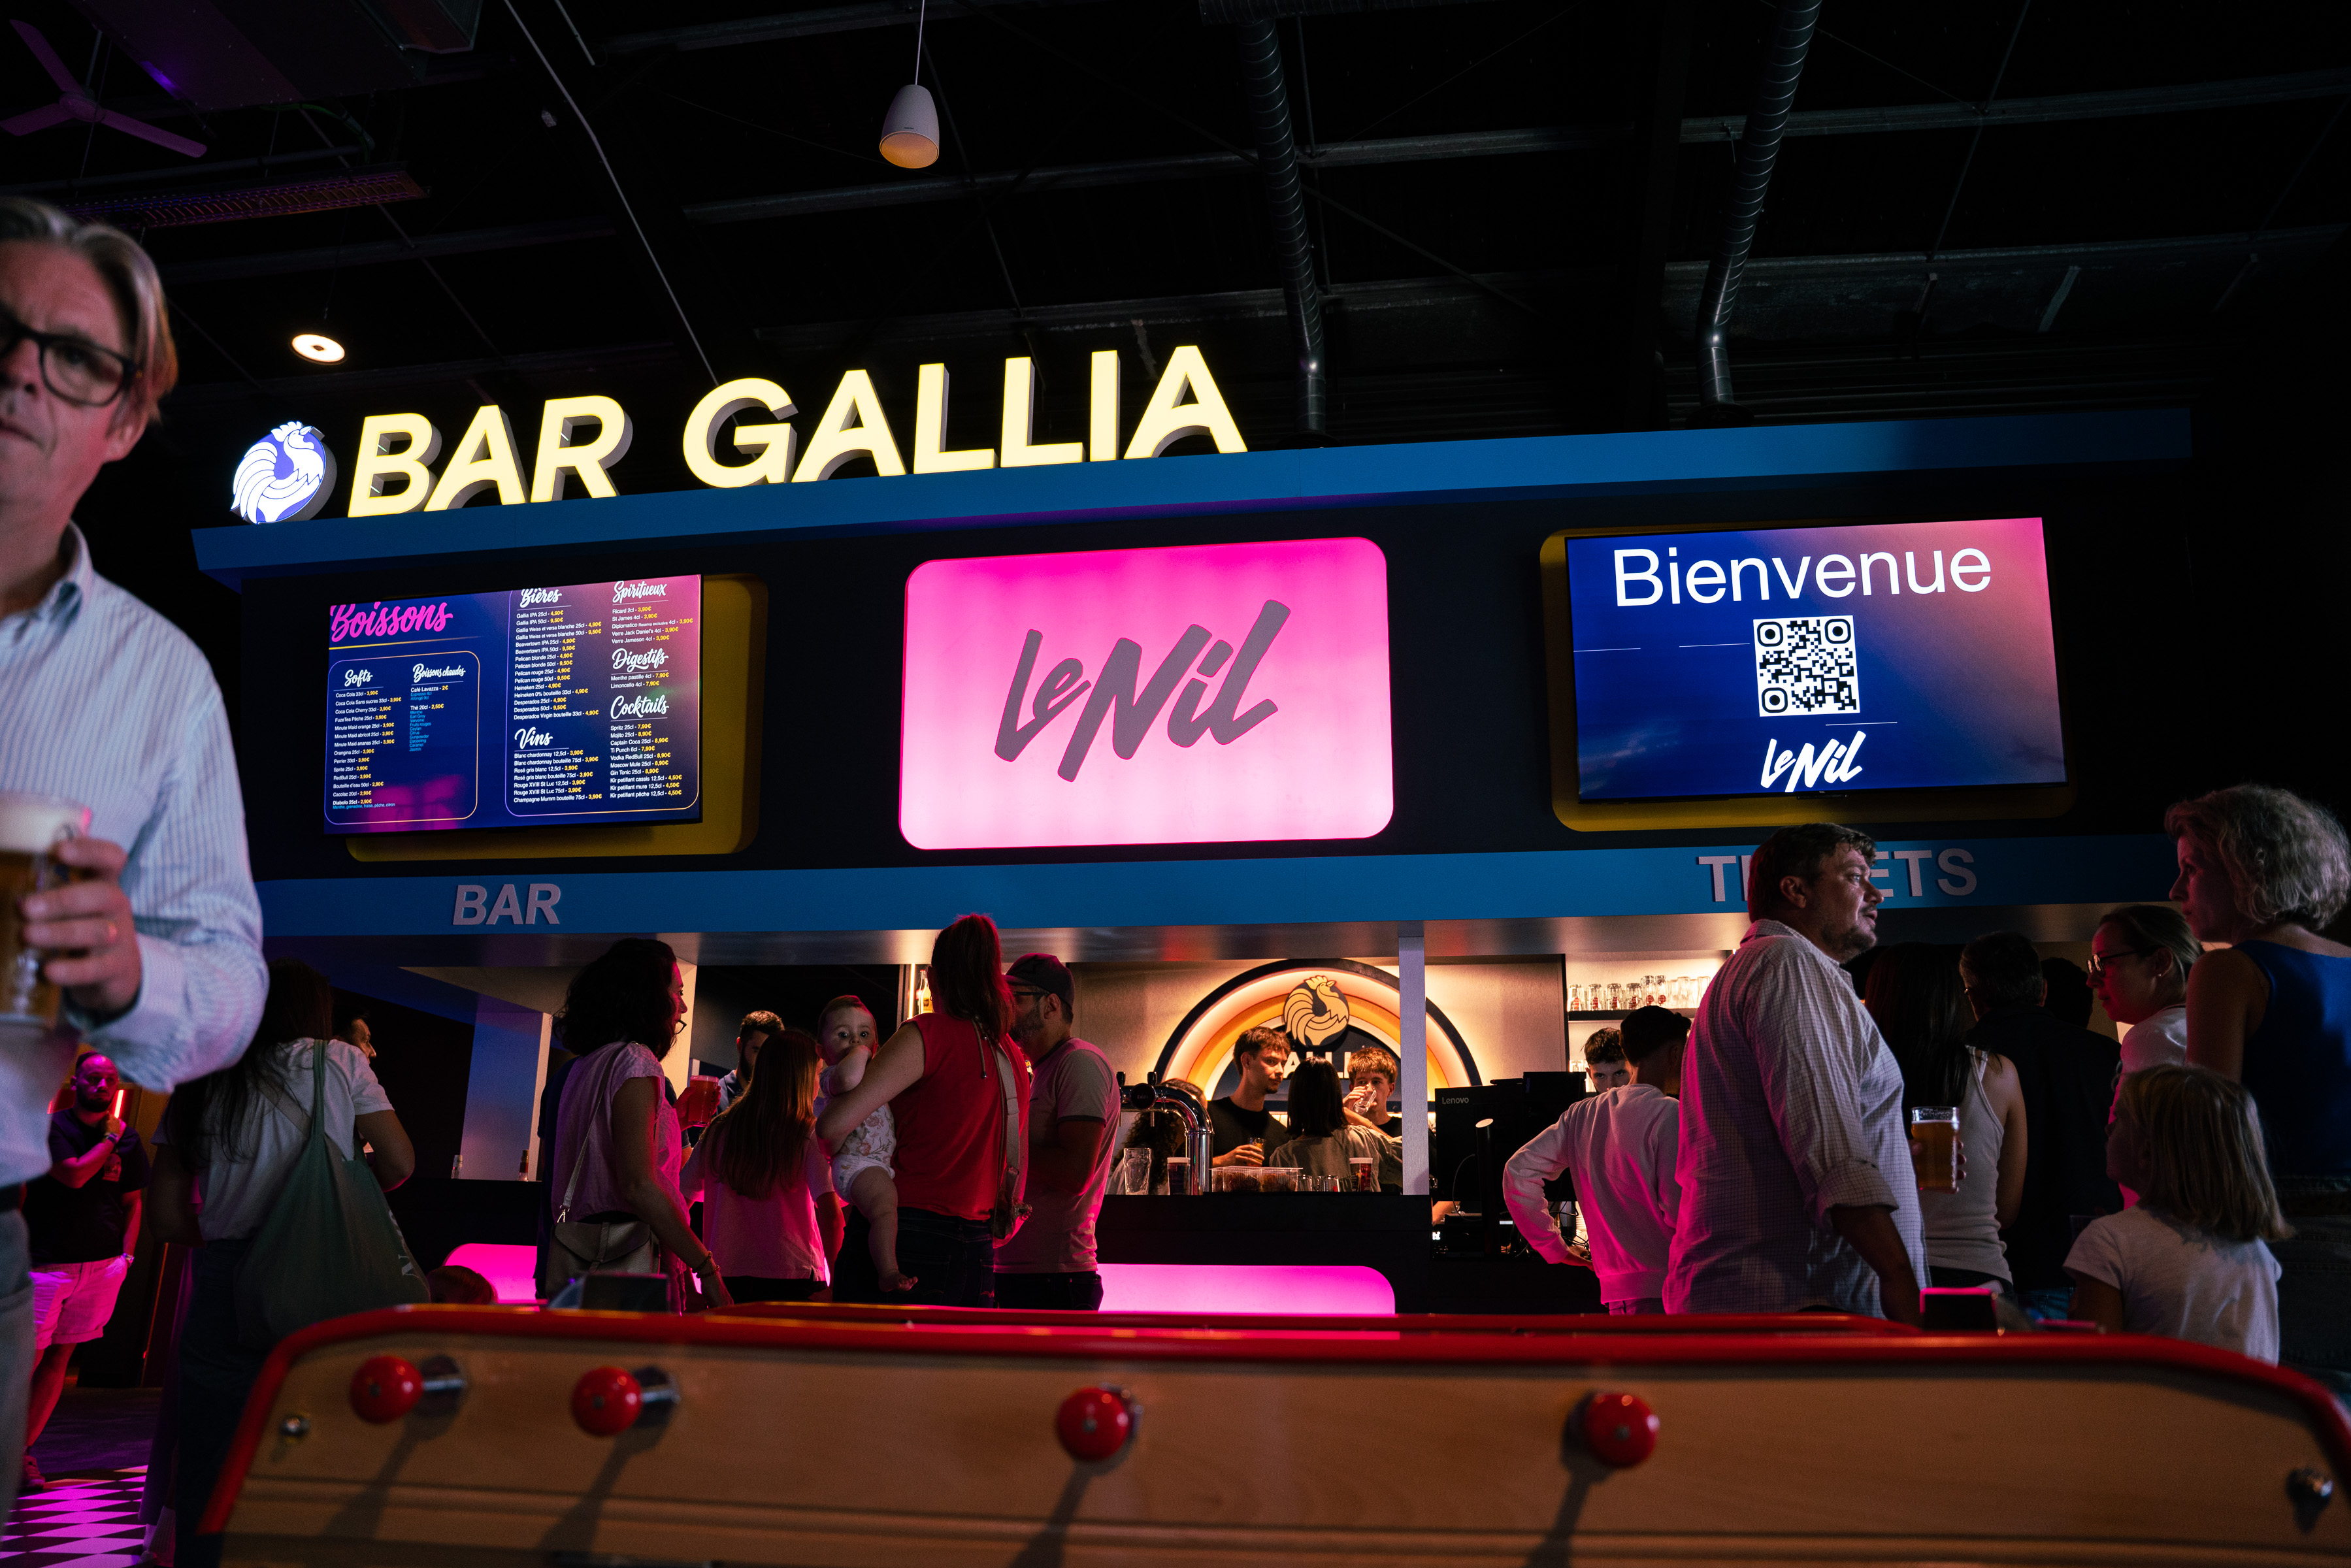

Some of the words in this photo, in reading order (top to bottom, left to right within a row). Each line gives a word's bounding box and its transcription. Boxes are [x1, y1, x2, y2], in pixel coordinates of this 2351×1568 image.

[348, 395, 629, 517] BAR
[683, 346, 1248, 489] GALLIA
[1614, 546, 1992, 607] Bienvenue
[519, 587, 562, 608] Bières
[612, 580, 667, 604] Spiritueux
[330, 601, 453, 642] Boissons
[612, 647, 669, 672] Digestifs
[344, 669, 372, 687] Softs
[412, 663, 442, 683] Boissons
[442, 664, 466, 676] chaudes
[610, 694, 670, 719] Cocktails
[514, 727, 553, 749] Vins
[1698, 848, 1977, 902] TIETS
[453, 883, 562, 926] BAR
